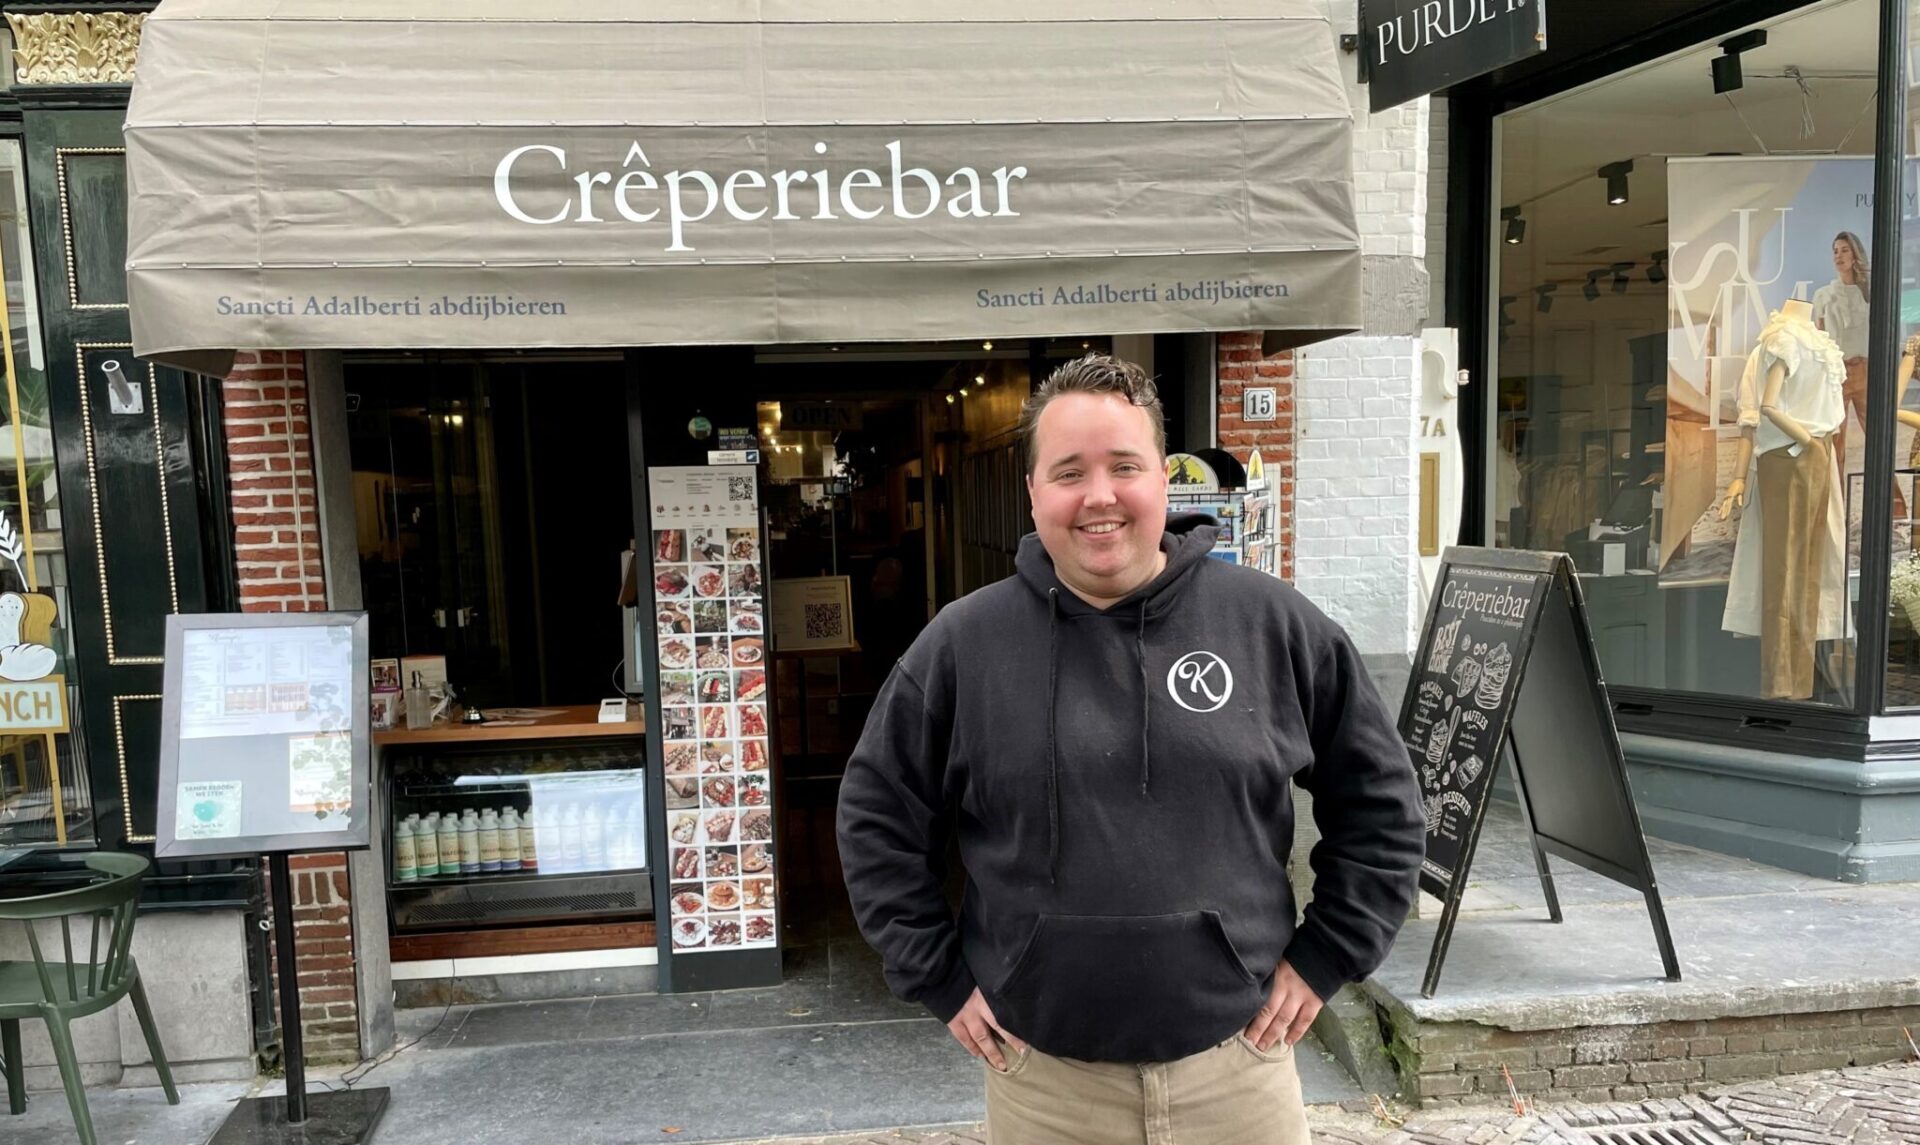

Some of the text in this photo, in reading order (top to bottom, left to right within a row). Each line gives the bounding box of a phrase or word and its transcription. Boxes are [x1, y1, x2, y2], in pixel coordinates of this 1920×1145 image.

[494, 140, 1028, 252] Crêperiebar
[976, 280, 1289, 308] Sancti Adalberti abdijbieren
[217, 295, 567, 321] Sancti Adalberti abdijbieren
[792, 406, 851, 425] OPEN
[1250, 393, 1271, 415] 15
[1441, 579, 1531, 619] Crêperiebar
[1462, 709, 1489, 731] WAFFLES
[1442, 790, 1472, 816] DESSERTS
